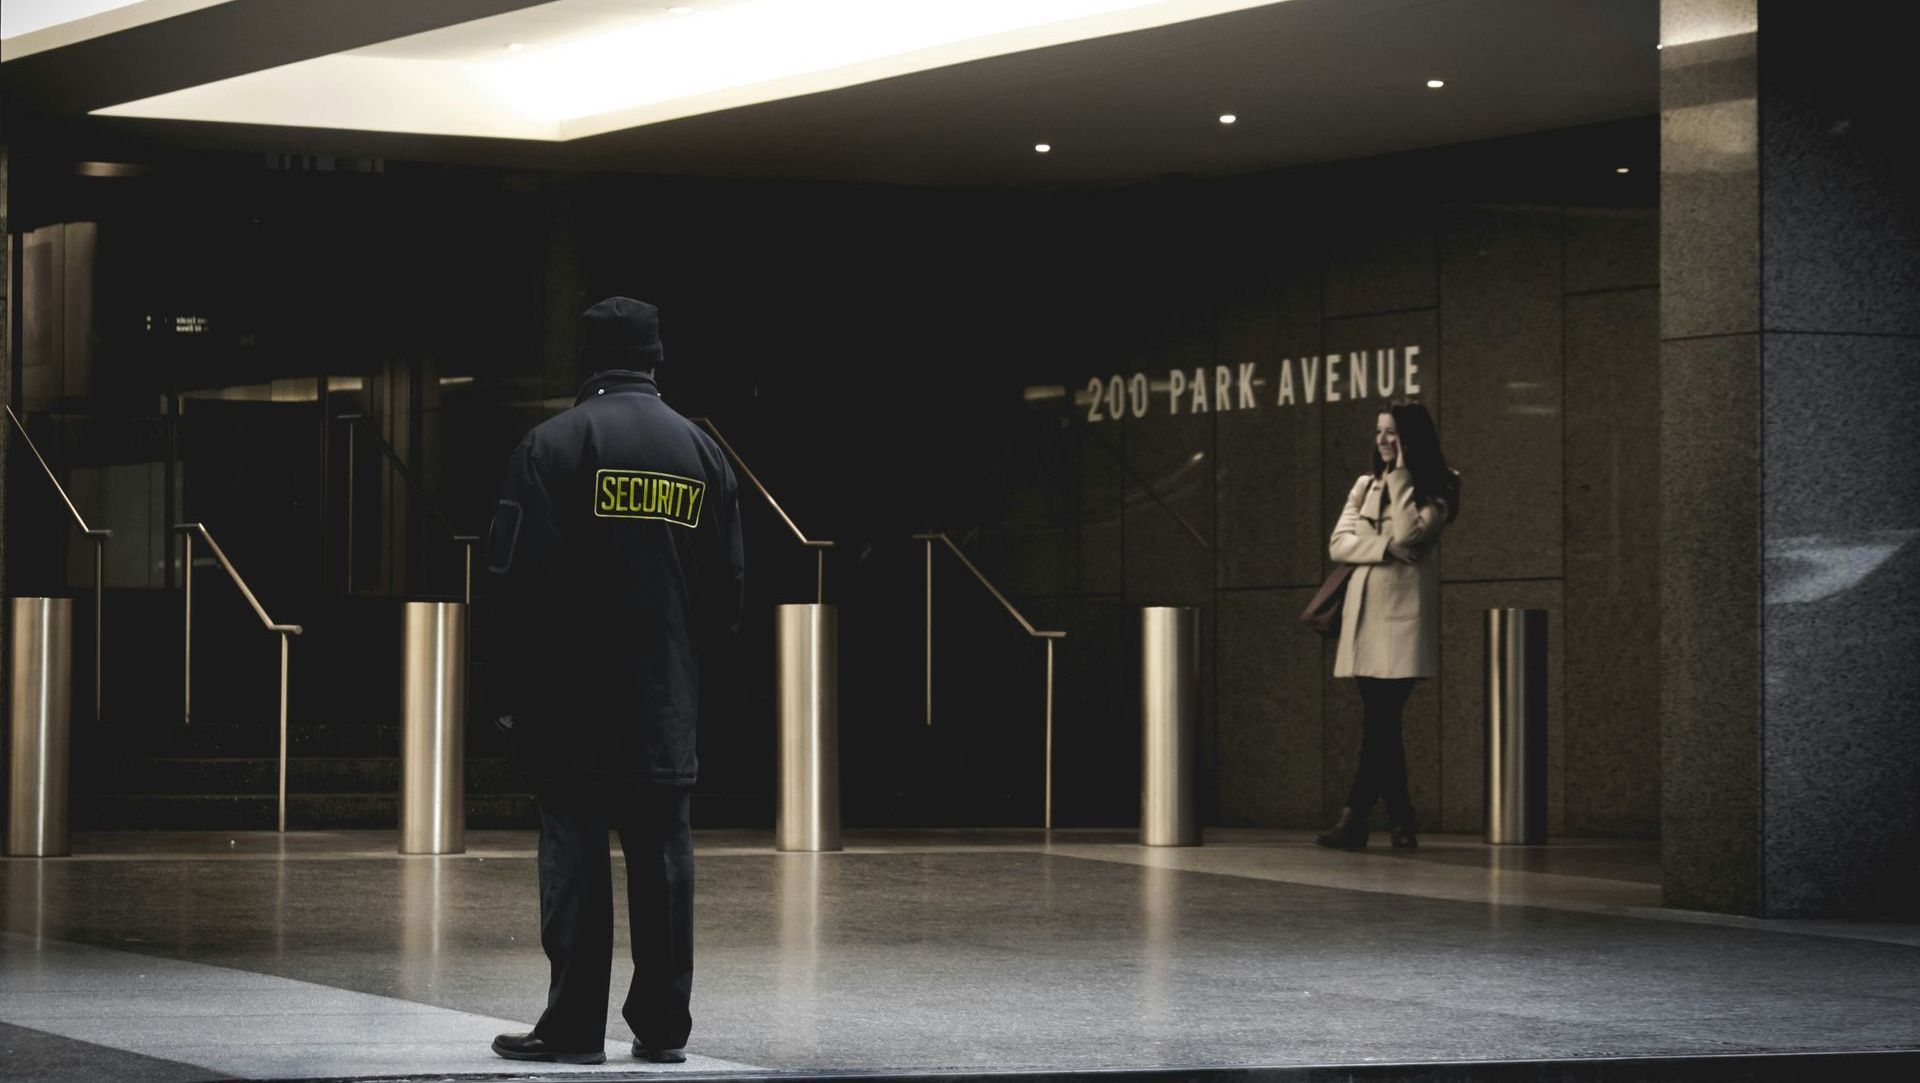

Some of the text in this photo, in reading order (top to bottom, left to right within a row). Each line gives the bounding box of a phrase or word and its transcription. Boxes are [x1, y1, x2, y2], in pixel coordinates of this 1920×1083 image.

[1087, 345, 1421, 423] 200 PARK AVENUE
[601, 476, 700, 520] SECURITY
